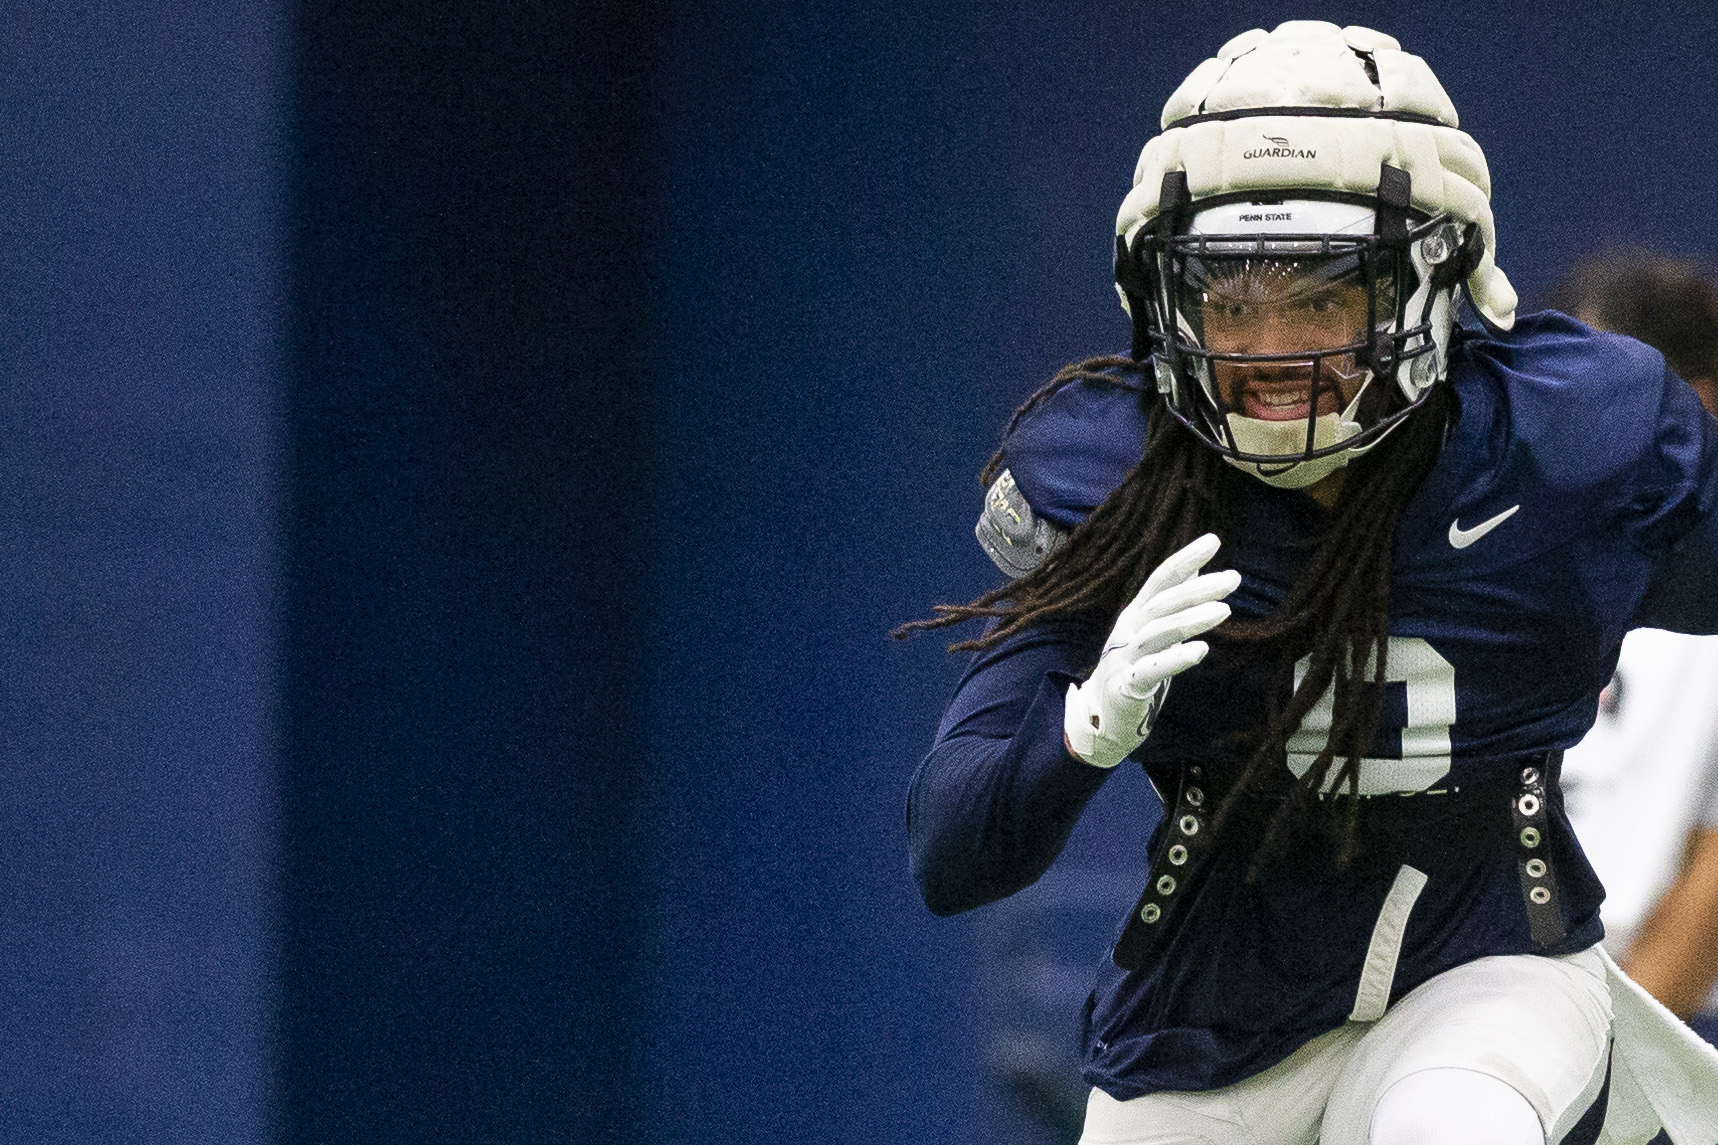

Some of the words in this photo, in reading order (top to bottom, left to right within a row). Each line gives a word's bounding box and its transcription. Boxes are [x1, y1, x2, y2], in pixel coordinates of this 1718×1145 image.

[1243, 147, 1317, 160] GUARDIAN
[1239, 213, 1263, 222] PENN
[1264, 212, 1292, 221] STATE
